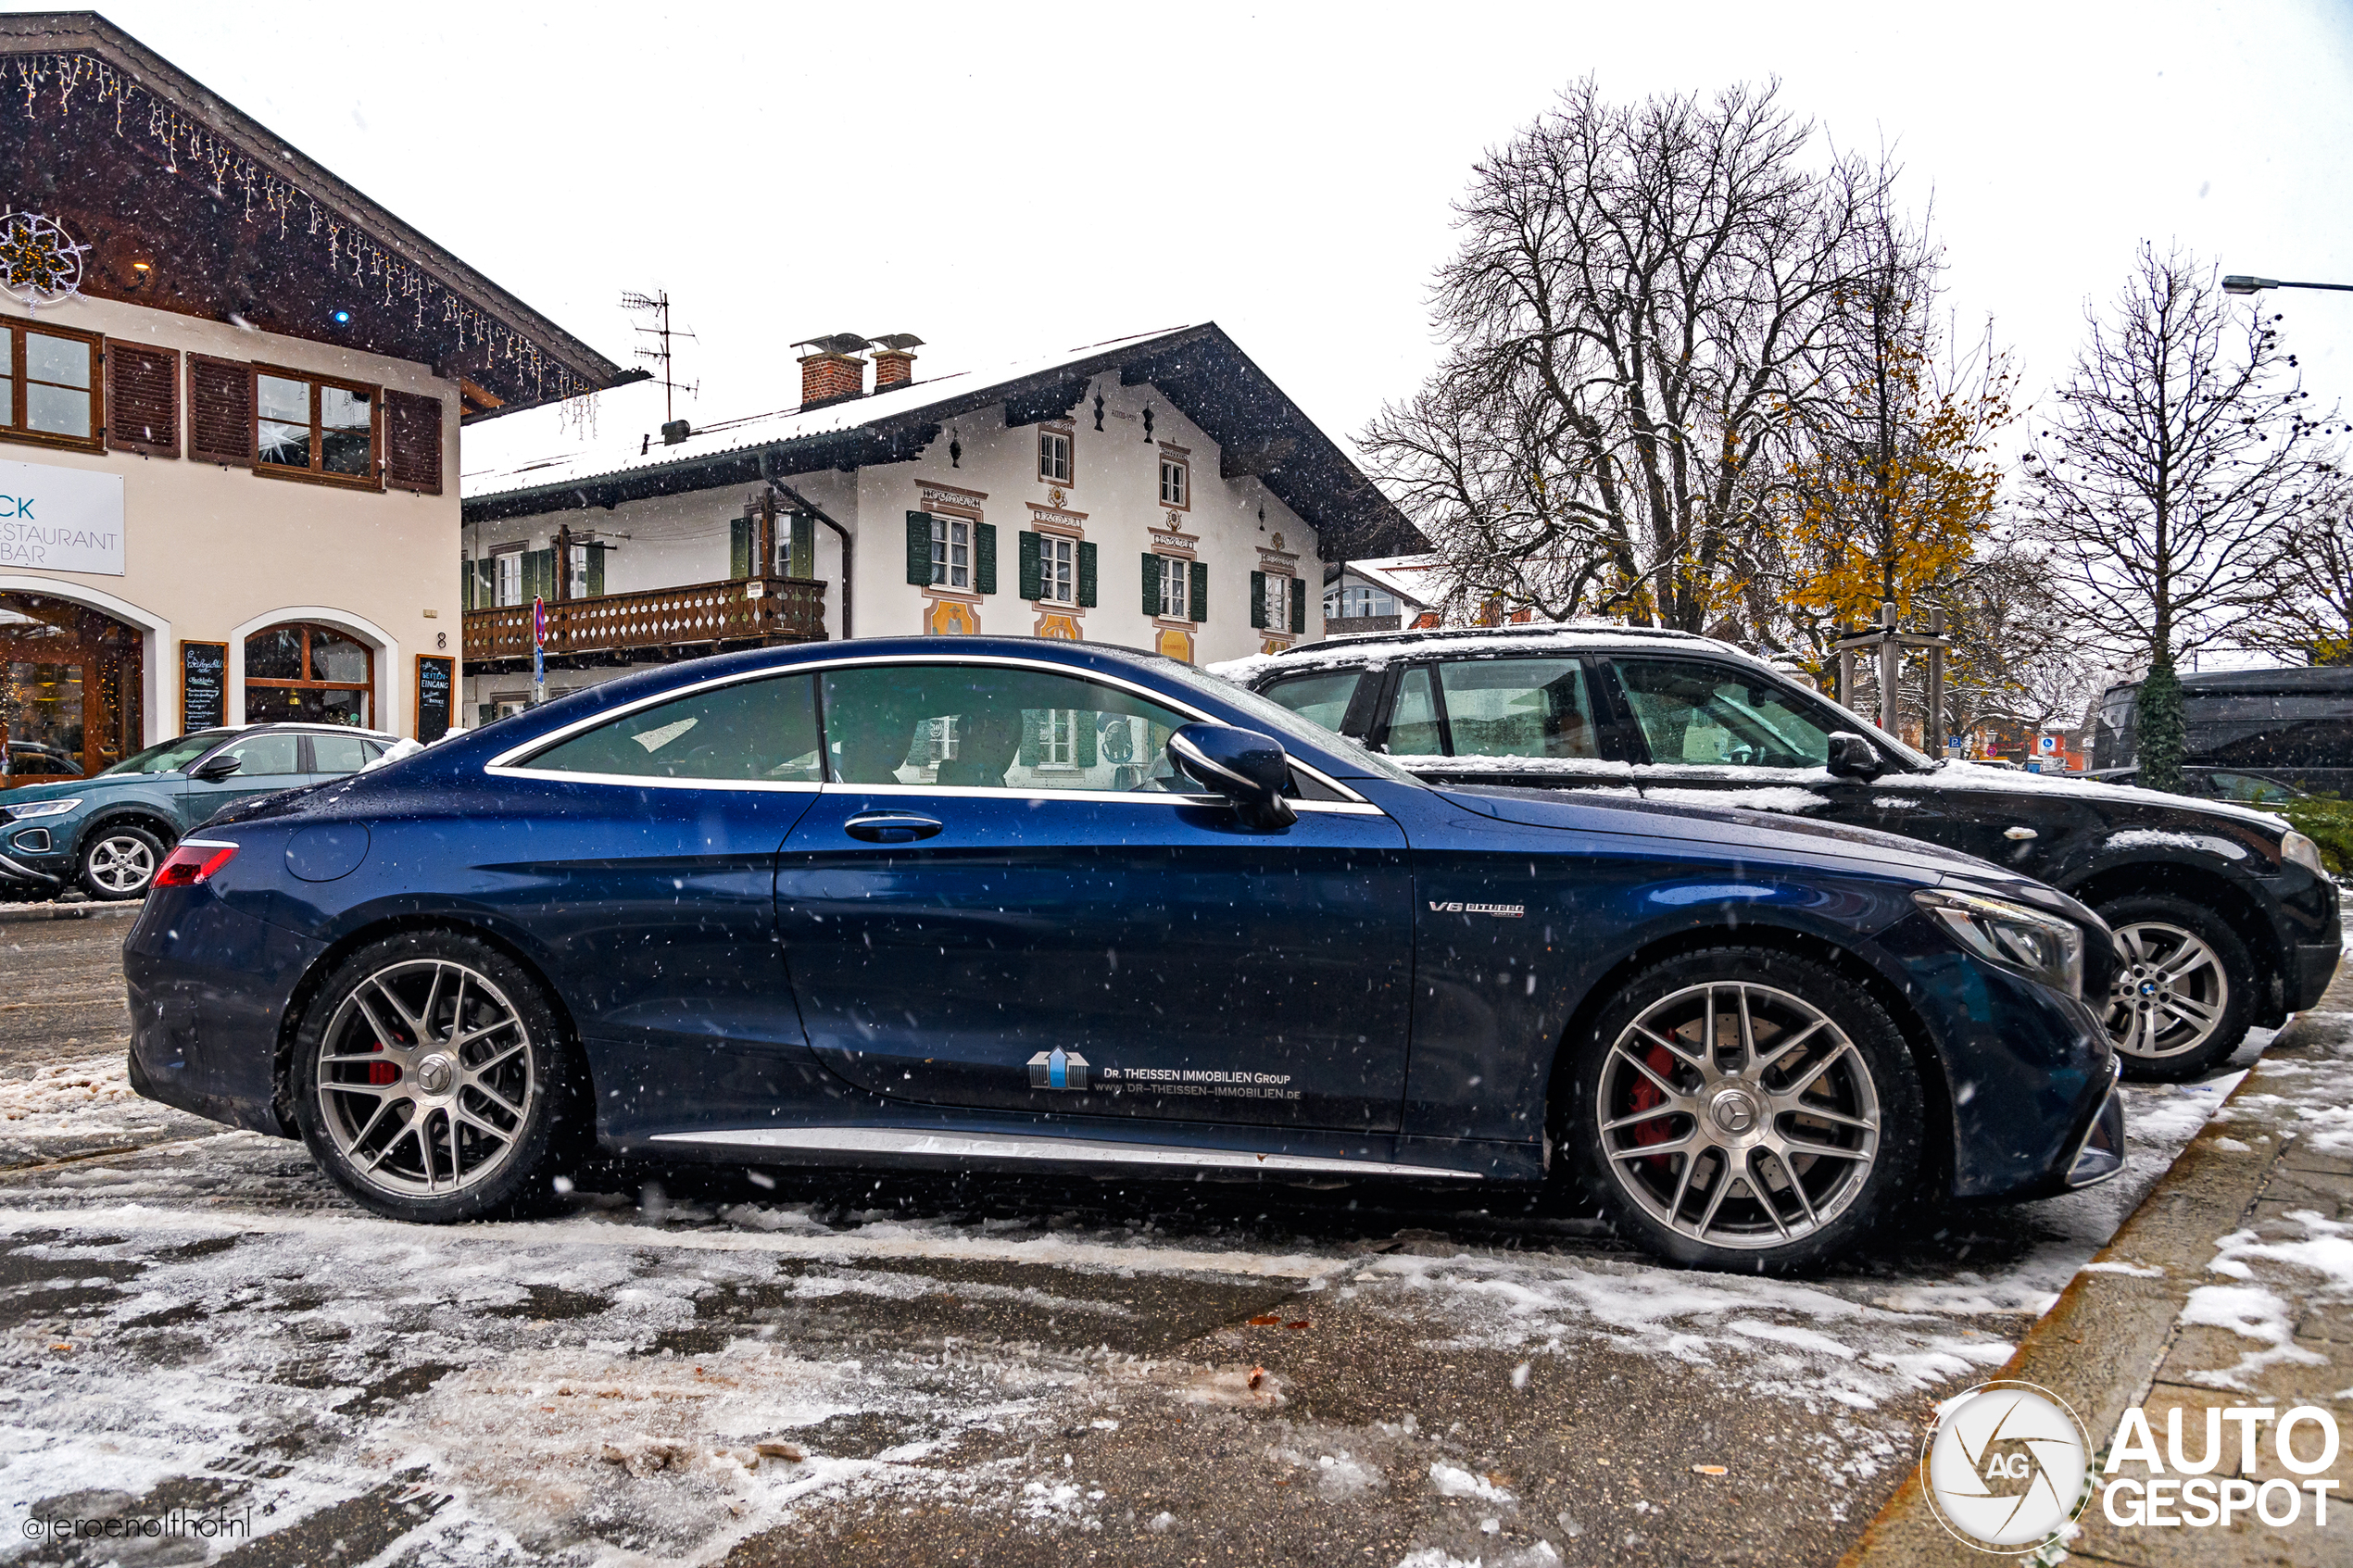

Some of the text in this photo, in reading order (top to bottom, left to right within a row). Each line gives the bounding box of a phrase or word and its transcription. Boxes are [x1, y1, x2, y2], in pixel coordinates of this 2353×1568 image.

[0, 523, 119, 551] STAURANT
[1, 543, 45, 563] BAR
[437, 632, 447, 648] 8
[422, 680, 449, 689] EINGANG
[1951, 738, 1958, 746] P
[1429, 901, 1525, 912] V8 BITURBO
[1124, 1068, 1180, 1081] THEISSEN
[1182, 1071, 1252, 1083] IMMOBILIEN
